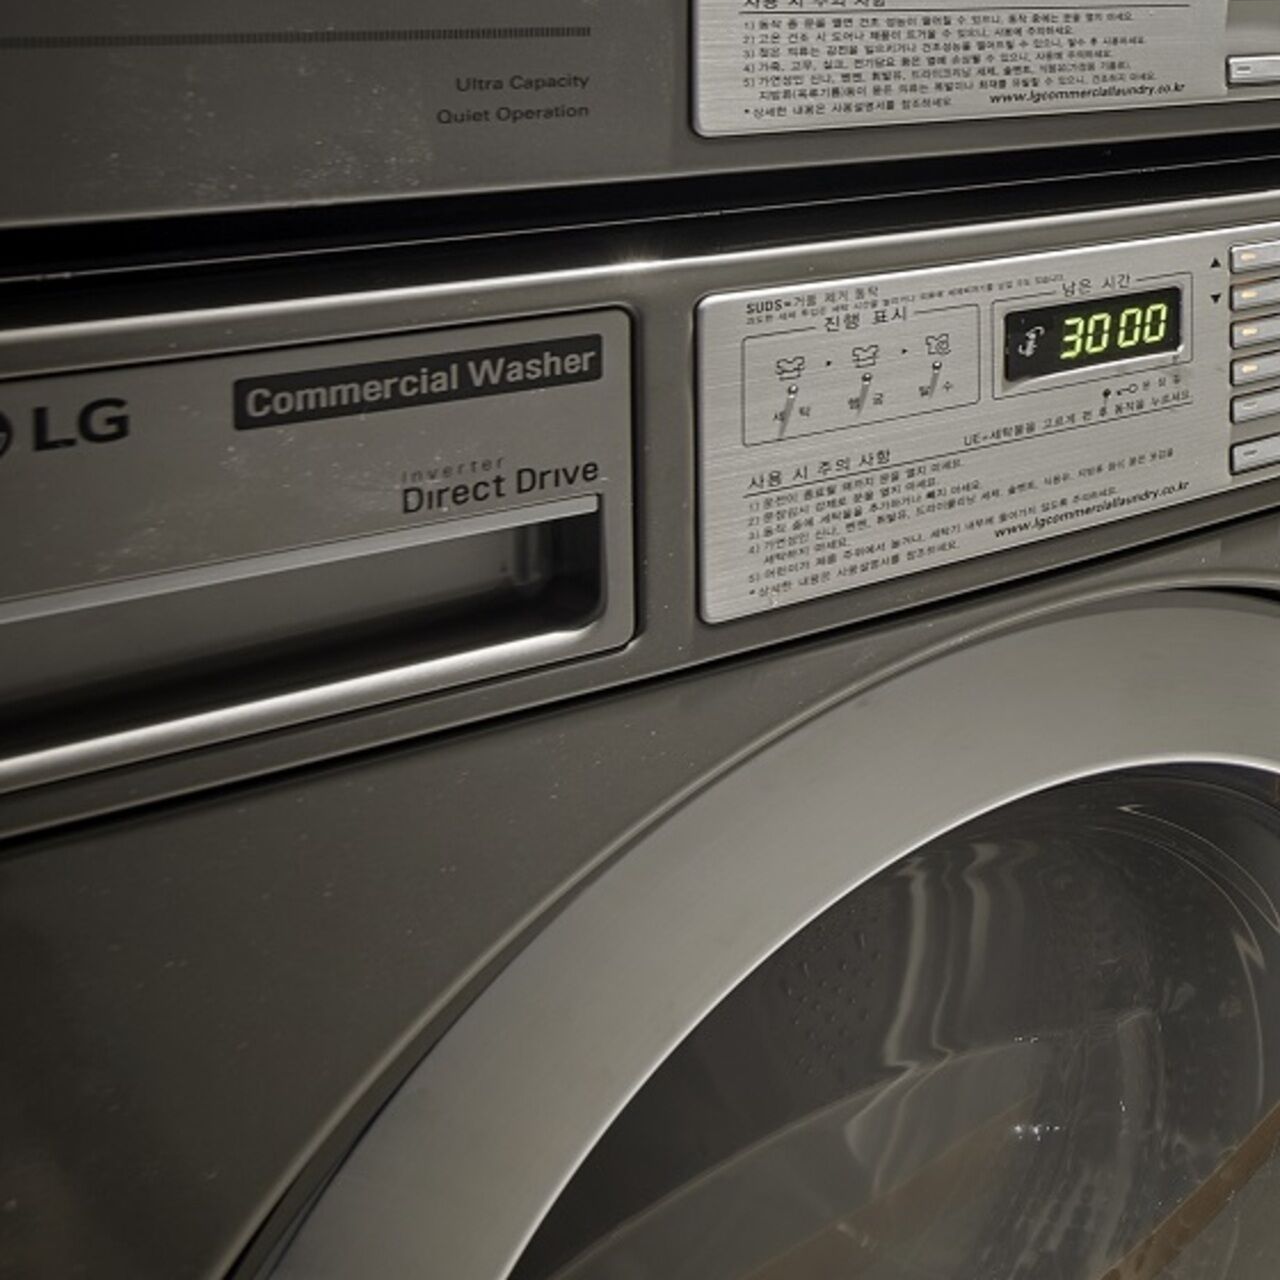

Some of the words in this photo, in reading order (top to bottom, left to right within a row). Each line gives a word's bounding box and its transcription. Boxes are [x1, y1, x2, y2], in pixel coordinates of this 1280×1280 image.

[456, 77, 504, 92] Ultra
[509, 74, 590, 91] Capacity
[989, 82, 1185, 104] www.lgcommerciallaundry.co.kr
[436, 109, 490, 124] Quiet
[495, 105, 589, 123] Operation
[1062, 279, 1091, 297] 남은
[1102, 273, 1130, 290] 시간
[824, 313, 860, 333] 진행
[873, 307, 908, 325] 표시
[246, 363, 459, 417] Commercial
[468, 348, 596, 388] Washer
[32, 397, 130, 451] LG
[749, 471, 782, 489] 사용
[793, 466, 808, 481] 시
[818, 457, 849, 475] 주의
[859, 450, 890, 466] 사항
[402, 475, 506, 515] Direct
[516, 461, 599, 495] Drive
[994, 481, 1190, 538] www.lgcommerciallaundry.co.kr
